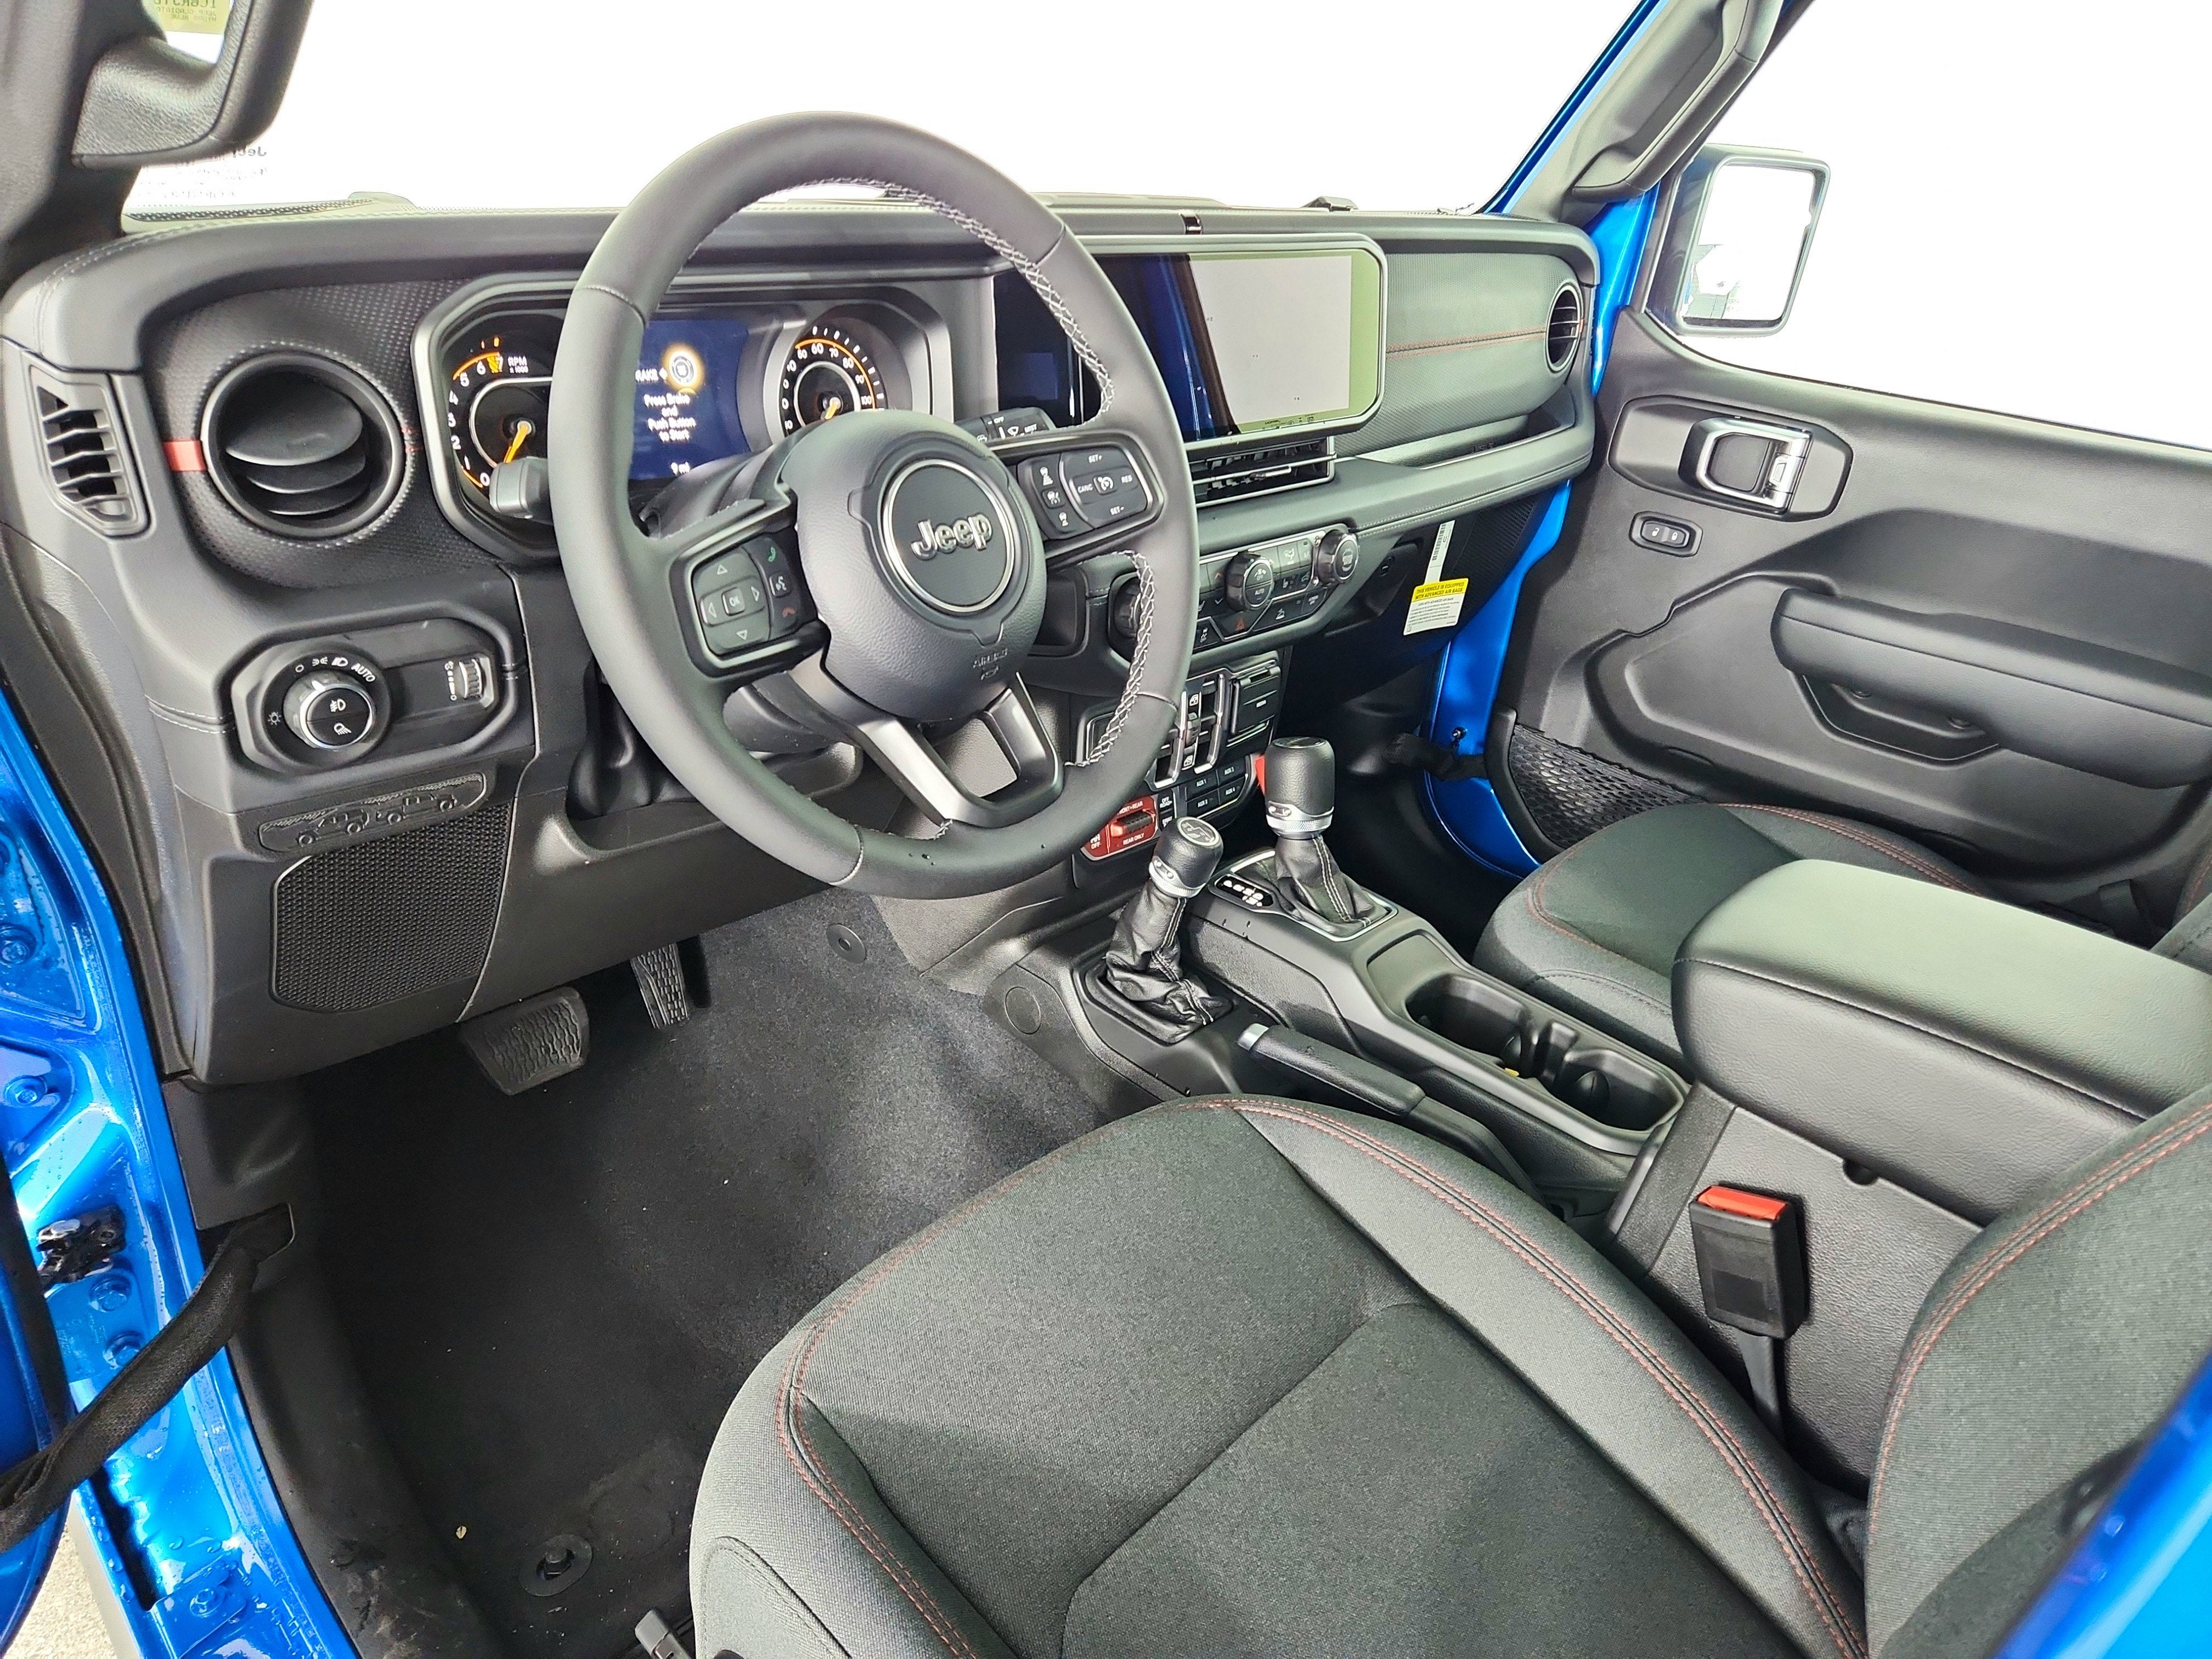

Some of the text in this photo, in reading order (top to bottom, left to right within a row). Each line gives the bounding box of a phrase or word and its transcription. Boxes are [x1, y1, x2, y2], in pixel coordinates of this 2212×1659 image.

[811, 343, 823, 354] 60
[829, 348, 839, 358] 70
[508, 356, 528, 366] RPM
[843, 357, 854, 369] 80
[477, 361, 486, 375] 6
[460, 372, 470, 387] 5
[855, 375, 865, 384] 90
[449, 390, 459, 405] 4
[861, 396, 872, 405] 100
[662, 405, 679, 417] and
[448, 413, 456, 427] 3
[668, 417, 697, 428] Button
[451, 435, 461, 450] 2
[659, 429, 690, 443] to Start
[464, 455, 471, 470] 1
[480, 472, 490, 487] 0
[911, 512, 994, 561] Jeep
[729, 596, 741, 606] OK
[351, 663, 375, 681] AUTO
[1123, 833, 1144, 845] REAR ONLY
